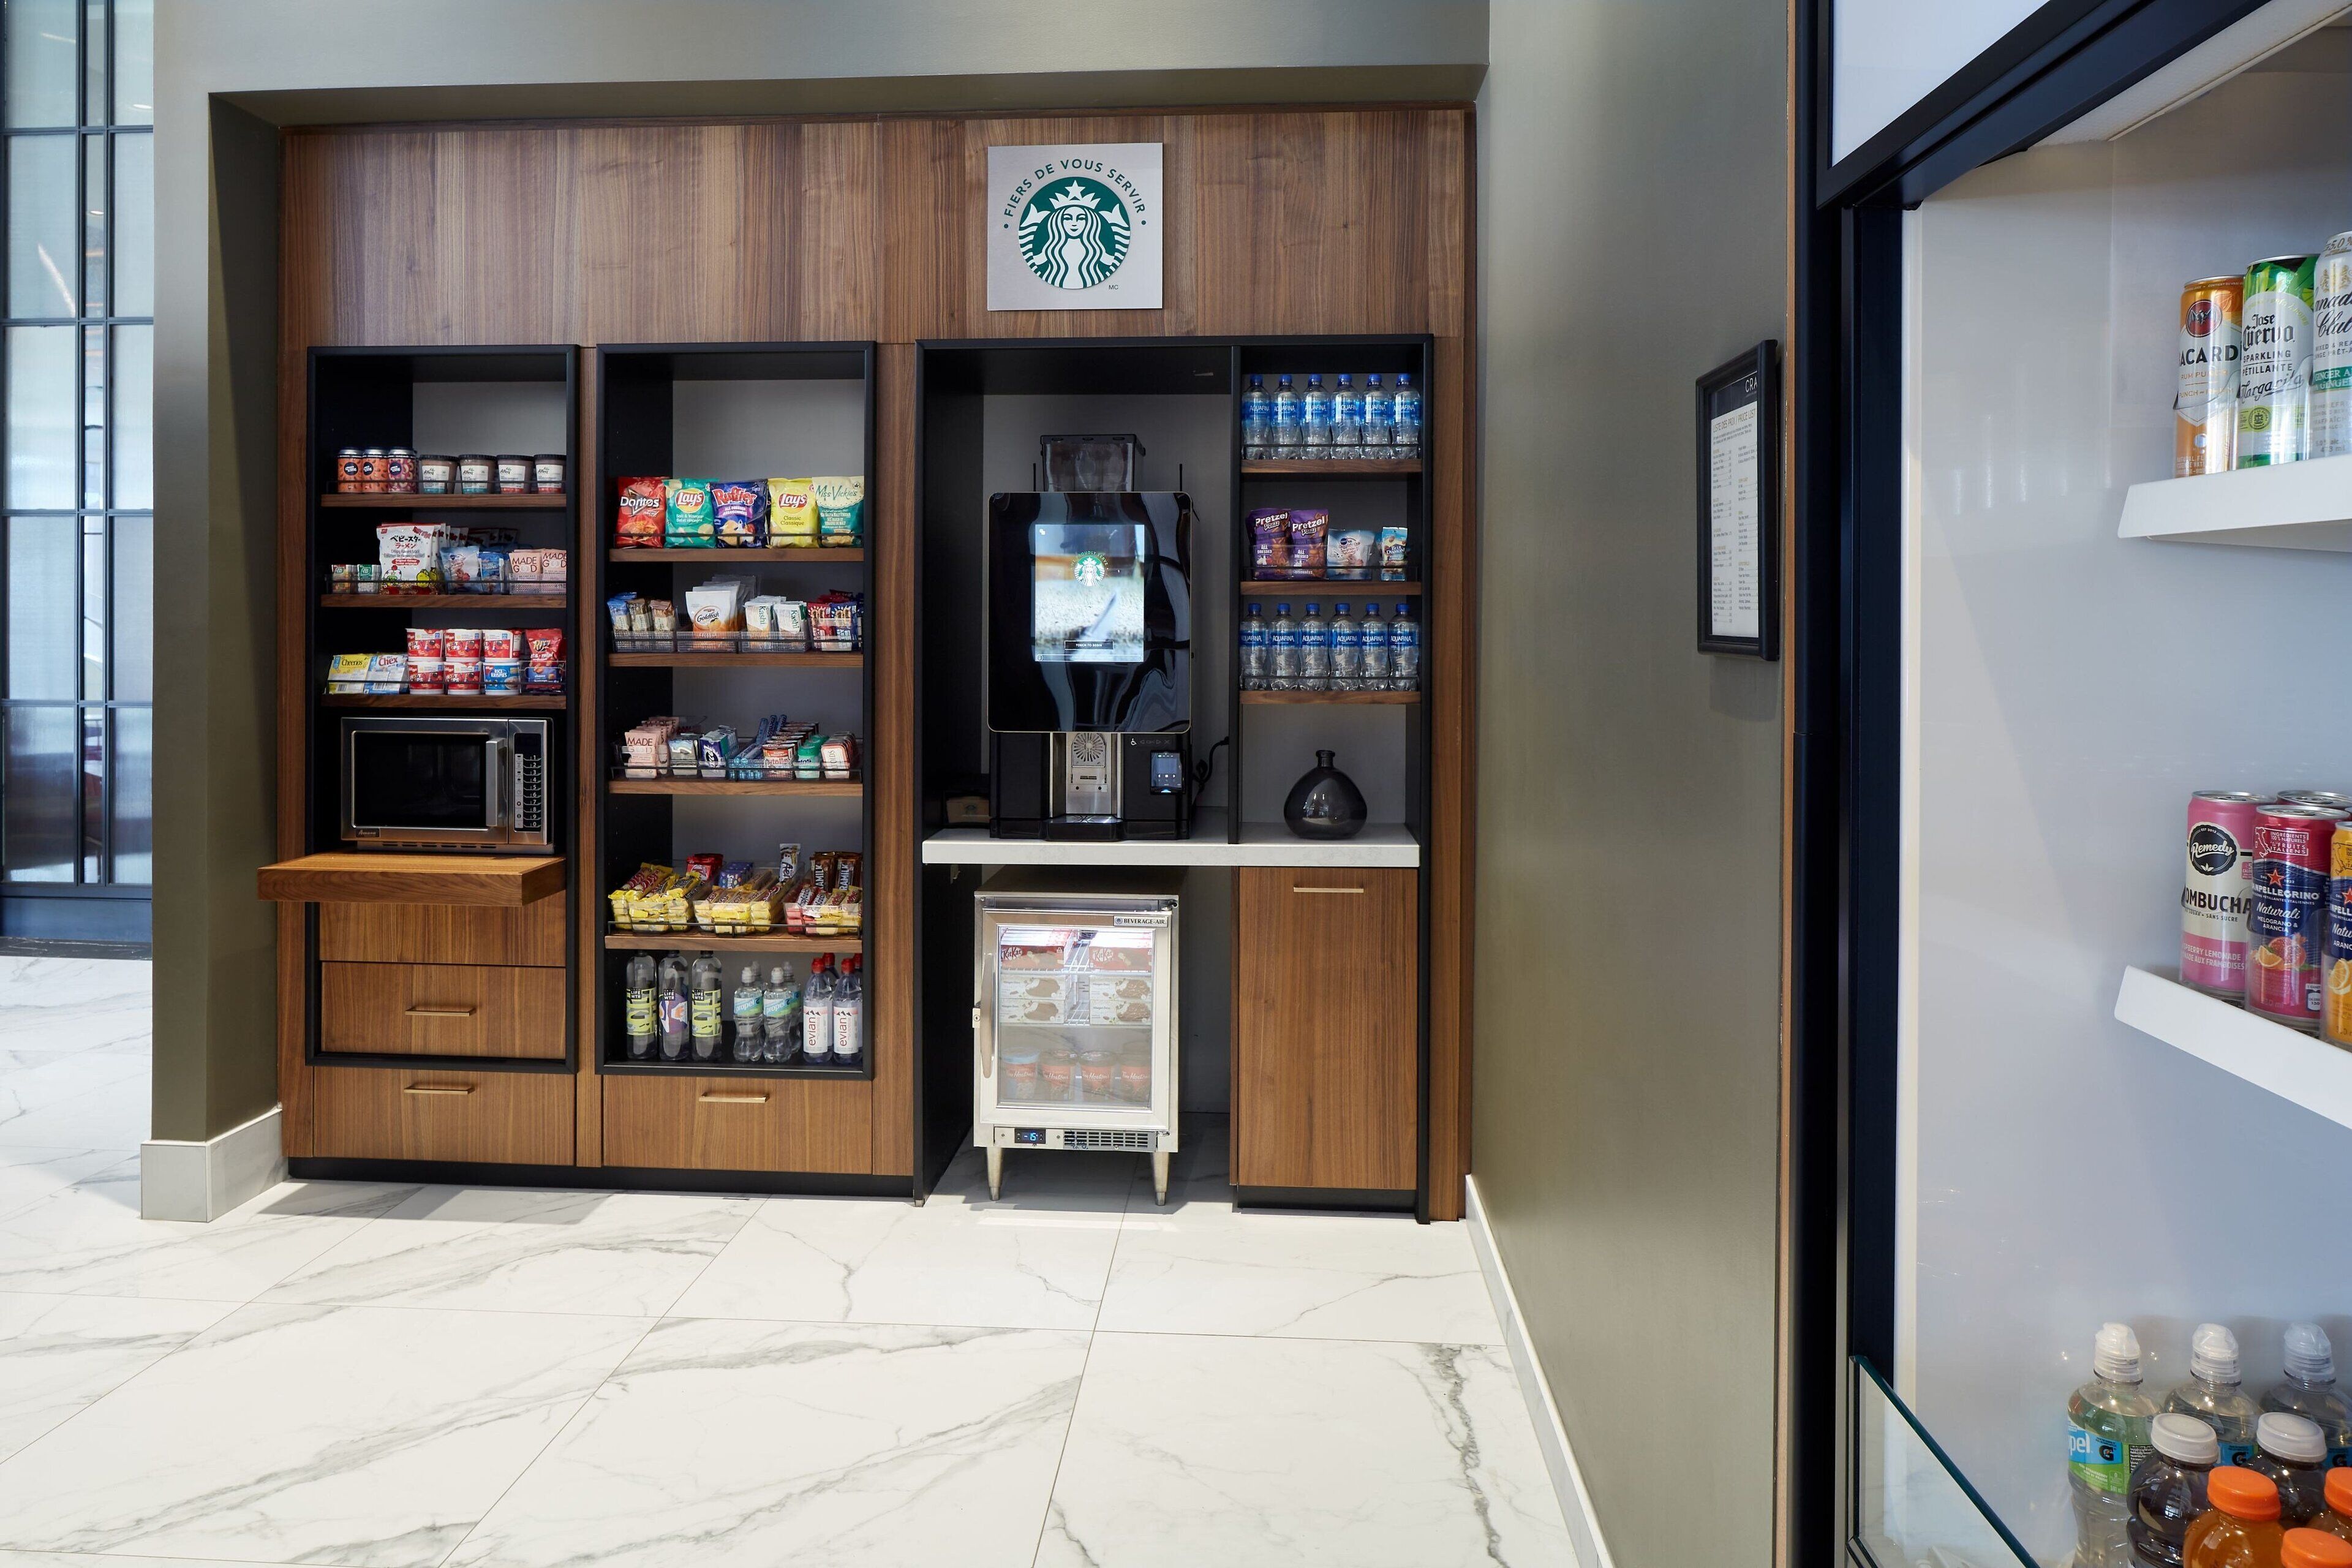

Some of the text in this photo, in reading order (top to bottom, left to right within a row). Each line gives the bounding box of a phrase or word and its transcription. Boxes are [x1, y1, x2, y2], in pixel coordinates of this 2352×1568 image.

[1004, 159, 1145, 217] FIERS DE VOUS SERVIR
[2252, 314, 2275, 329] Jose
[2179, 342, 2242, 367] ACARD
[2243, 350, 2291, 364] SPARKLING
[2242, 363, 2293, 377] PÉTILLANTE
[712, 486, 758, 507] Ruffles
[815, 484, 831, 499] Miss
[620, 496, 660, 510] Doritos
[1256, 513, 1288, 526] Pretzel
[1292, 516, 1325, 532] Pretzel
[696, 611, 720, 622] Goldfish
[791, 610, 799, 628] Kashi
[378, 656, 398, 666] Chex
[627, 737, 653, 746] MADE
[2270, 831, 2307, 839] INGRÉDIENTS
[2191, 840, 2234, 862] Remedy
[2269, 846, 2306, 854] ITALIENS
[2252, 883, 2320, 900] ANPELLEGRINO
[2185, 887, 2252, 914] OMBUCHA
[2256, 902, 2301, 919] Naturali
[2257, 916, 2292, 927] MELOGRANO
[2263, 924, 2289, 933] ARANCIA
[1003, 947, 1022, 960] KitKat
